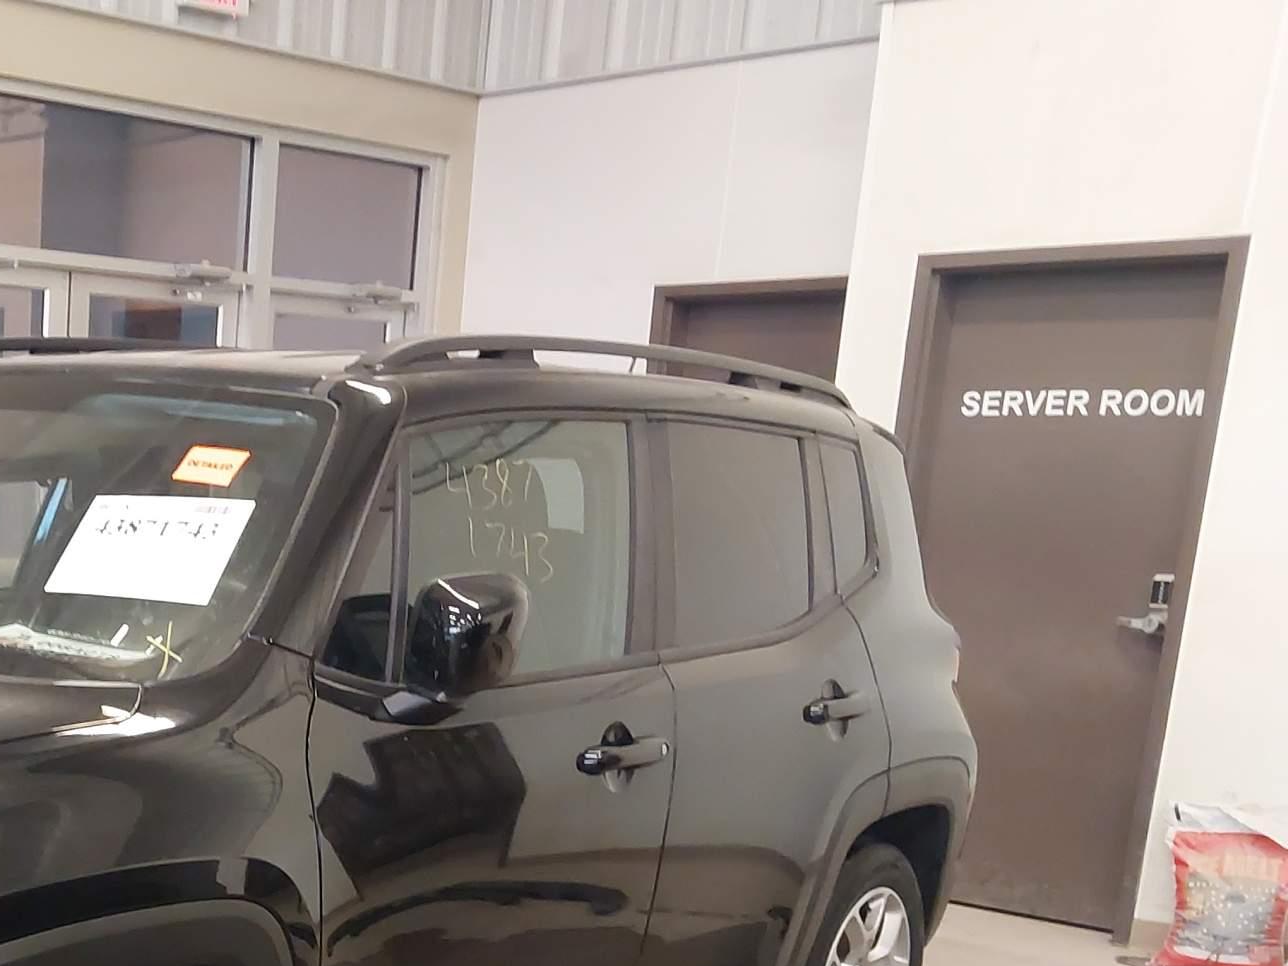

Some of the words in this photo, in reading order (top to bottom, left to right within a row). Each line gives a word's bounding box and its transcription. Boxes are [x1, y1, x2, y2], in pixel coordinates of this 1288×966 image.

[960, 388, 1090, 418] SERVER
[1098, 388, 1206, 417] ROOM
[445, 458, 534, 511] 4387
[468, 516, 554, 583] 1743
